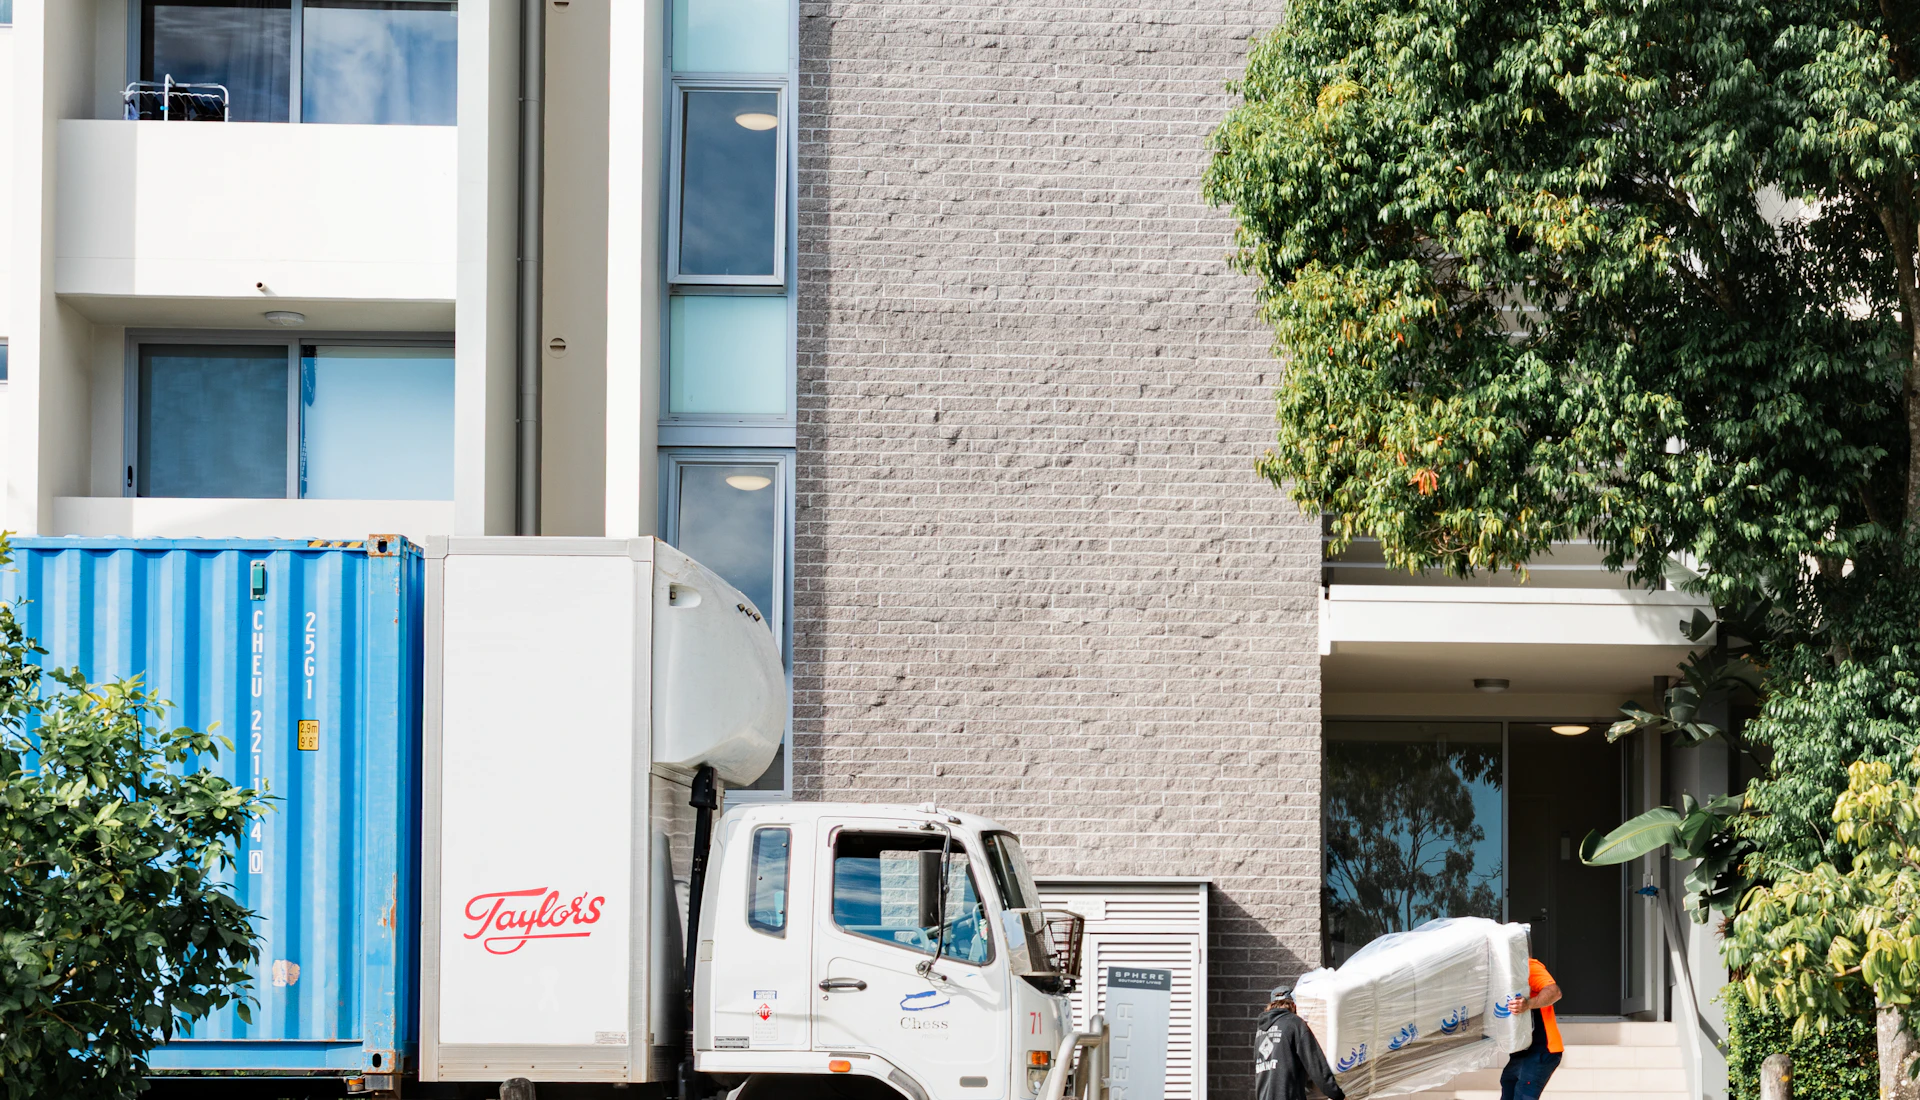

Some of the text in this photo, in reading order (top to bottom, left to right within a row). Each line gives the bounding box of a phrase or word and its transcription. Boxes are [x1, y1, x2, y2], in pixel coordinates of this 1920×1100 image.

[251, 610, 263, 698] CHEU
[304, 611, 316, 700] 25G1
[250, 851, 262, 873] 0
[463, 886, 606, 955] Taylor's
[1115, 971, 1165, 981] SPHERE
[900, 1016, 949, 1030] Chess
[1030, 1011, 1042, 1035] 71
